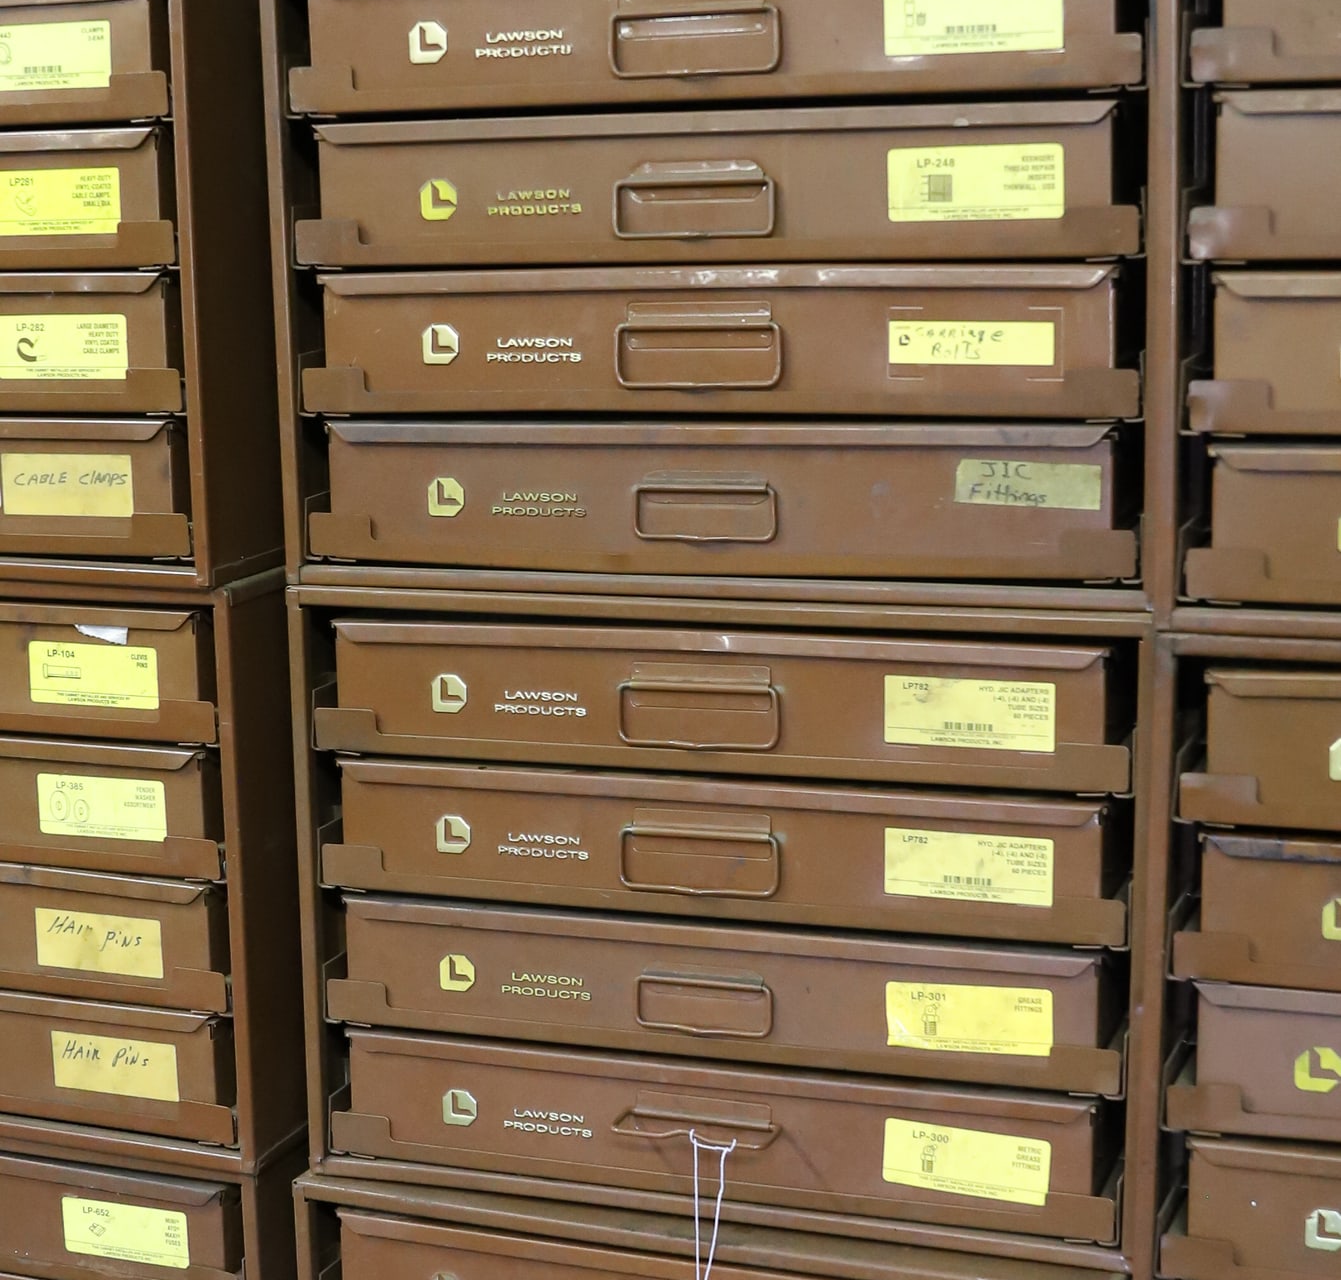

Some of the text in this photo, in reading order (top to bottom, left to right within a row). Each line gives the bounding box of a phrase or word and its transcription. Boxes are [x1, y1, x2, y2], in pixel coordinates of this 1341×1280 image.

[485, 30, 563, 43] LAWSON
[497, 189, 570, 201] LAWSON
[487, 203, 582, 216] PRODUCTS
[497, 337, 573, 348] LAWSON
[487, 352, 582, 363] PRODUCTS
[980, 462, 1032, 480] JIC
[14, 472, 67, 485] CABLE
[503, 492, 577, 502] LAWSON
[492, 506, 586, 517] PRODUCTS
[47, 649, 75, 658] LP-104
[505, 690, 578, 702] LAWSON
[495, 704, 587, 717] PRODUCTS
[56, 782, 83, 790] LP-385
[508, 833, 580, 845] LAWSON
[498, 846, 589, 861] PRODUCTS
[512, 972, 583, 986] LAWSON
[501, 985, 592, 1001] PRODUCTS
[911, 992, 946, 1001] LP-301
[1018, 997, 1042, 1005] GREASE
[1014, 1005, 1043, 1013] FITTINGS
[514, 1108, 584, 1124] LAWSON
[504, 1121, 593, 1138] PRODUCTS
[912, 1130, 949, 1144] LP-300
[1016, 1153, 1041, 1163] GREASE
[1012, 1161, 1040, 1171] FITTINGS
[83, 1206, 110, 1217] LP-652
